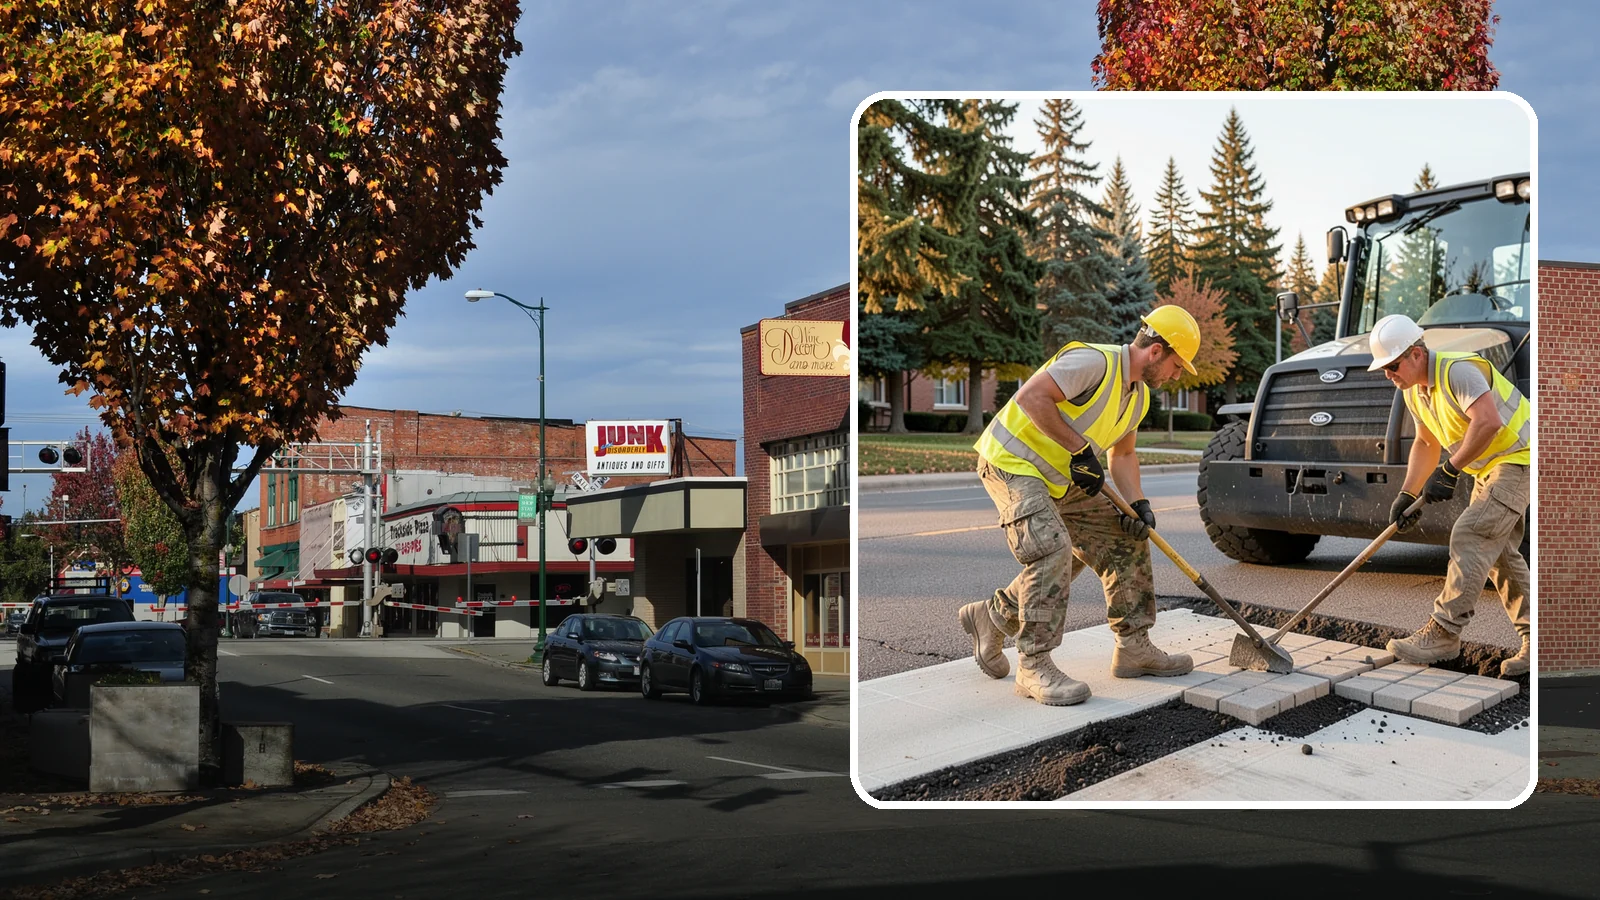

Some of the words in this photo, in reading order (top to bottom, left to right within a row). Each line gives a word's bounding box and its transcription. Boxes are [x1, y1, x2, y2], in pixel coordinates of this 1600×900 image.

[595, 425, 667, 457] JUNK
[607, 446, 646, 454] DISORDERLY
[596, 461, 628, 470] ANTIQUES
[631, 461, 644, 470] AND
[647, 460, 665, 469] GIFTS
[414, 519, 429, 535] Pizza
